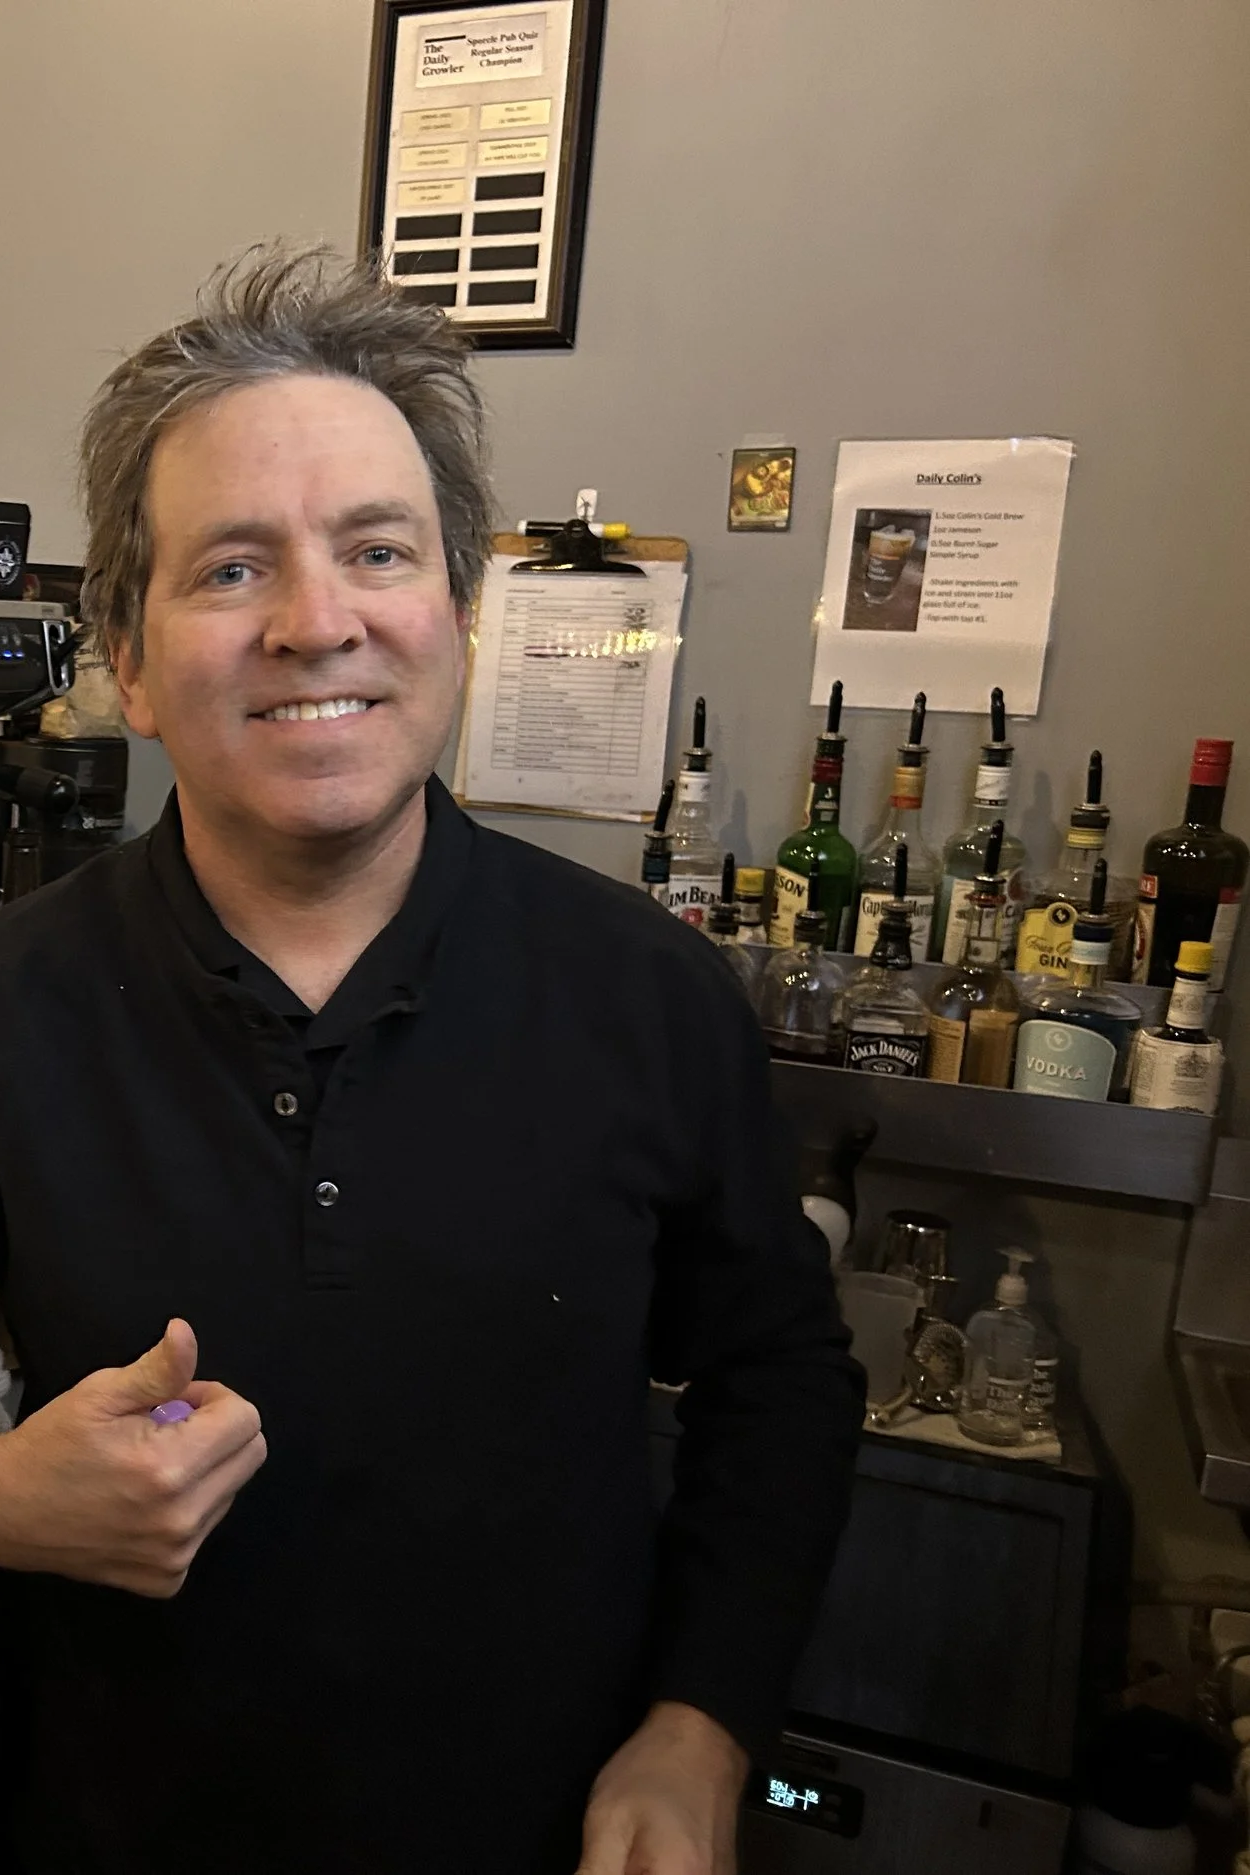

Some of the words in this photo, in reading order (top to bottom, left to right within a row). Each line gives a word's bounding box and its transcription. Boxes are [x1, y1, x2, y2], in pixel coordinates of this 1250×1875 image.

[500, 33, 517, 41] Pub
[518, 31, 539, 41] Quiz
[424, 45, 443, 54] The
[470, 47, 503, 57] Regular
[505, 44, 534, 53] Season
[423, 54, 449, 65] Daily
[479, 57, 522, 67] Champion
[422, 65, 464, 76] Growler
[916, 473, 944, 485] Daily
[946, 473, 982, 485] Colin's
[824, 787, 833, 799] J
[669, 890, 688, 907] IM
[1039, 953, 1068, 969] GIN
[851, 1043, 878, 1061] JACK
[1026, 1055, 1086, 1080] VODKA
